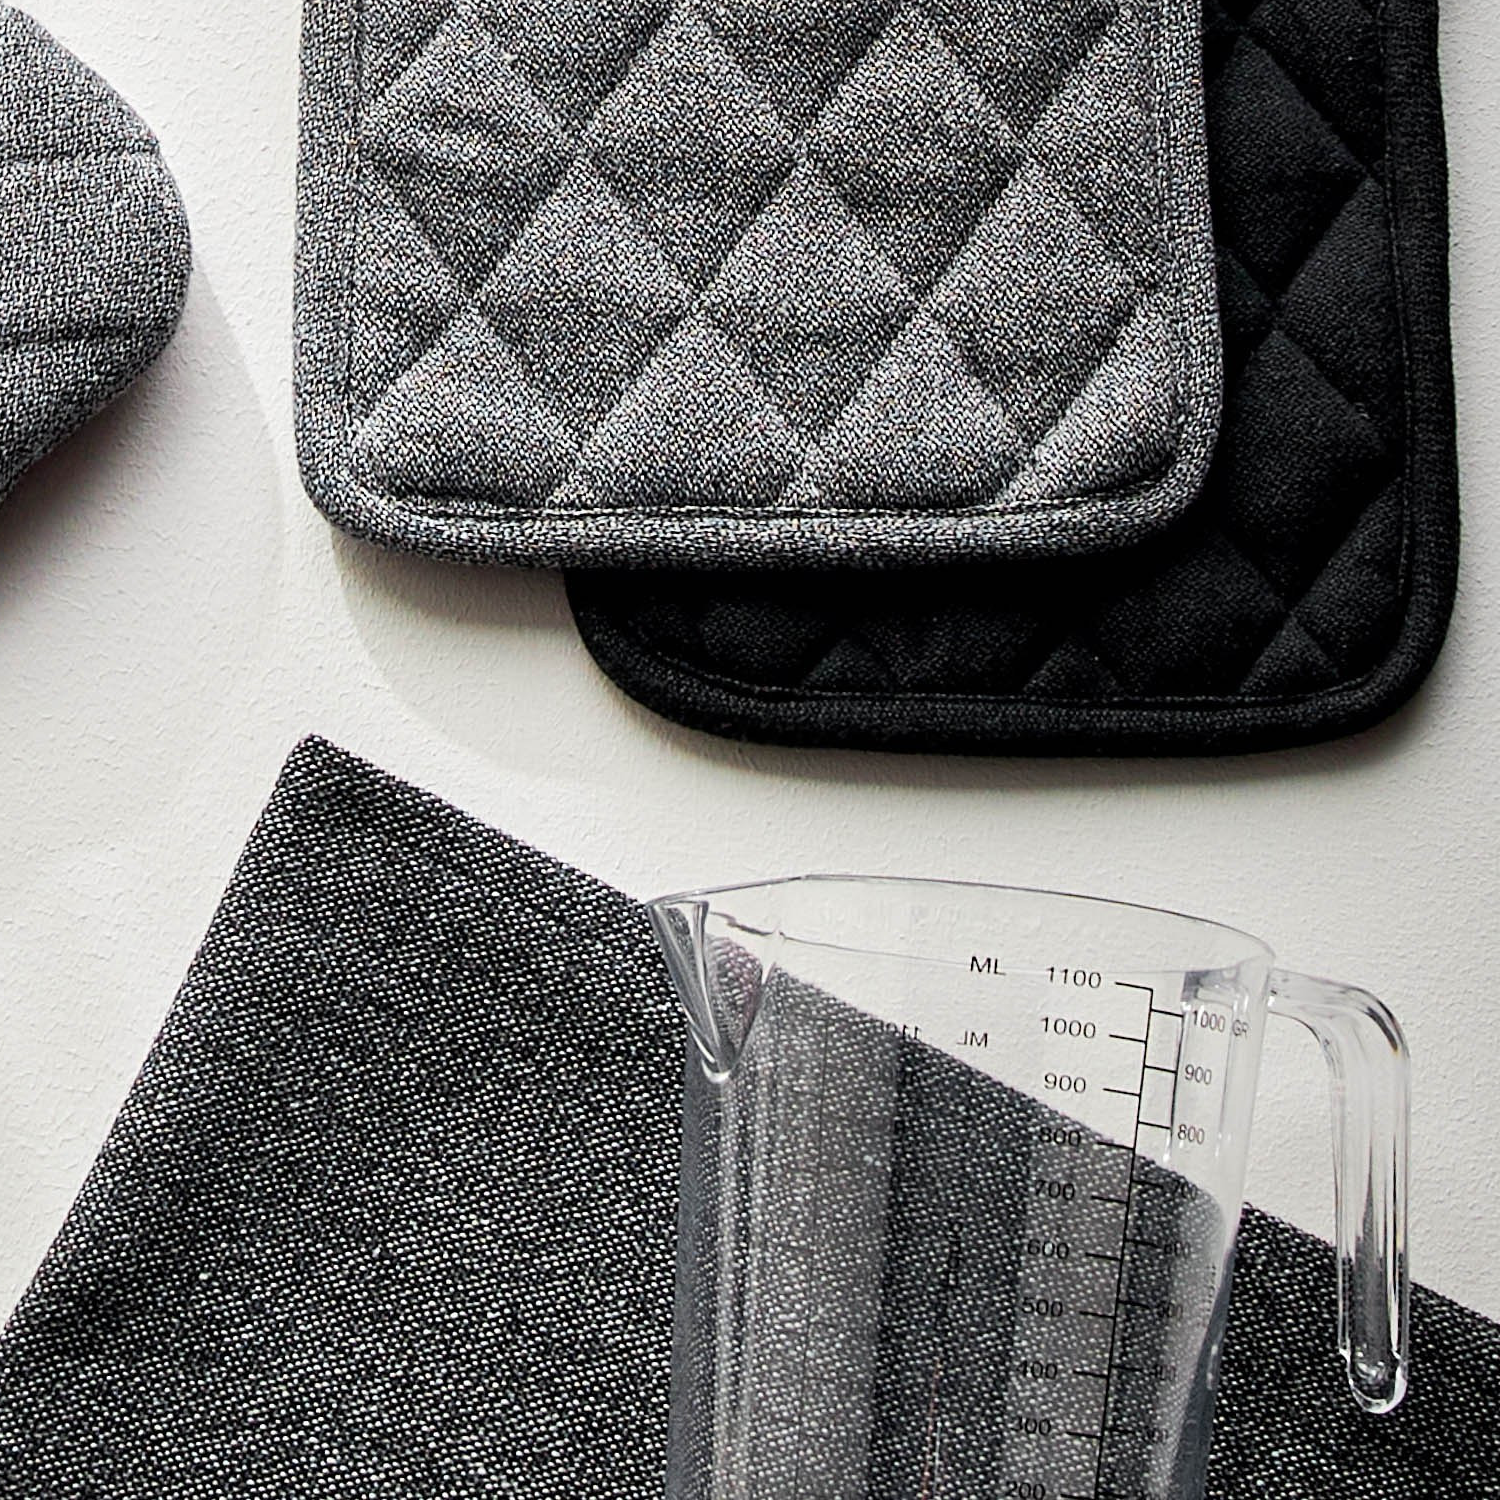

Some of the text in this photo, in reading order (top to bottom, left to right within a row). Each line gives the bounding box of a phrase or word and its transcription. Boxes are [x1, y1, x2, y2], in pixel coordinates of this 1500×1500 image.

[970, 956, 1006, 975] ML
[1046, 966, 1102, 989] 1100
[1040, 1016, 1097, 1039] 1000
[1192, 1009, 1226, 1033] 1000
[1043, 1072, 1087, 1094] 900
[1184, 1063, 1212, 1085] 900
[1038, 1126, 1082, 1147] 800
[1177, 1123, 1205, 1145] 800
[1035, 1179, 1076, 1200] 700
[1027, 1238, 1070, 1259] 600
[1021, 1297, 1064, 1318] 500
[1005, 1480, 1047, 1500] 200
